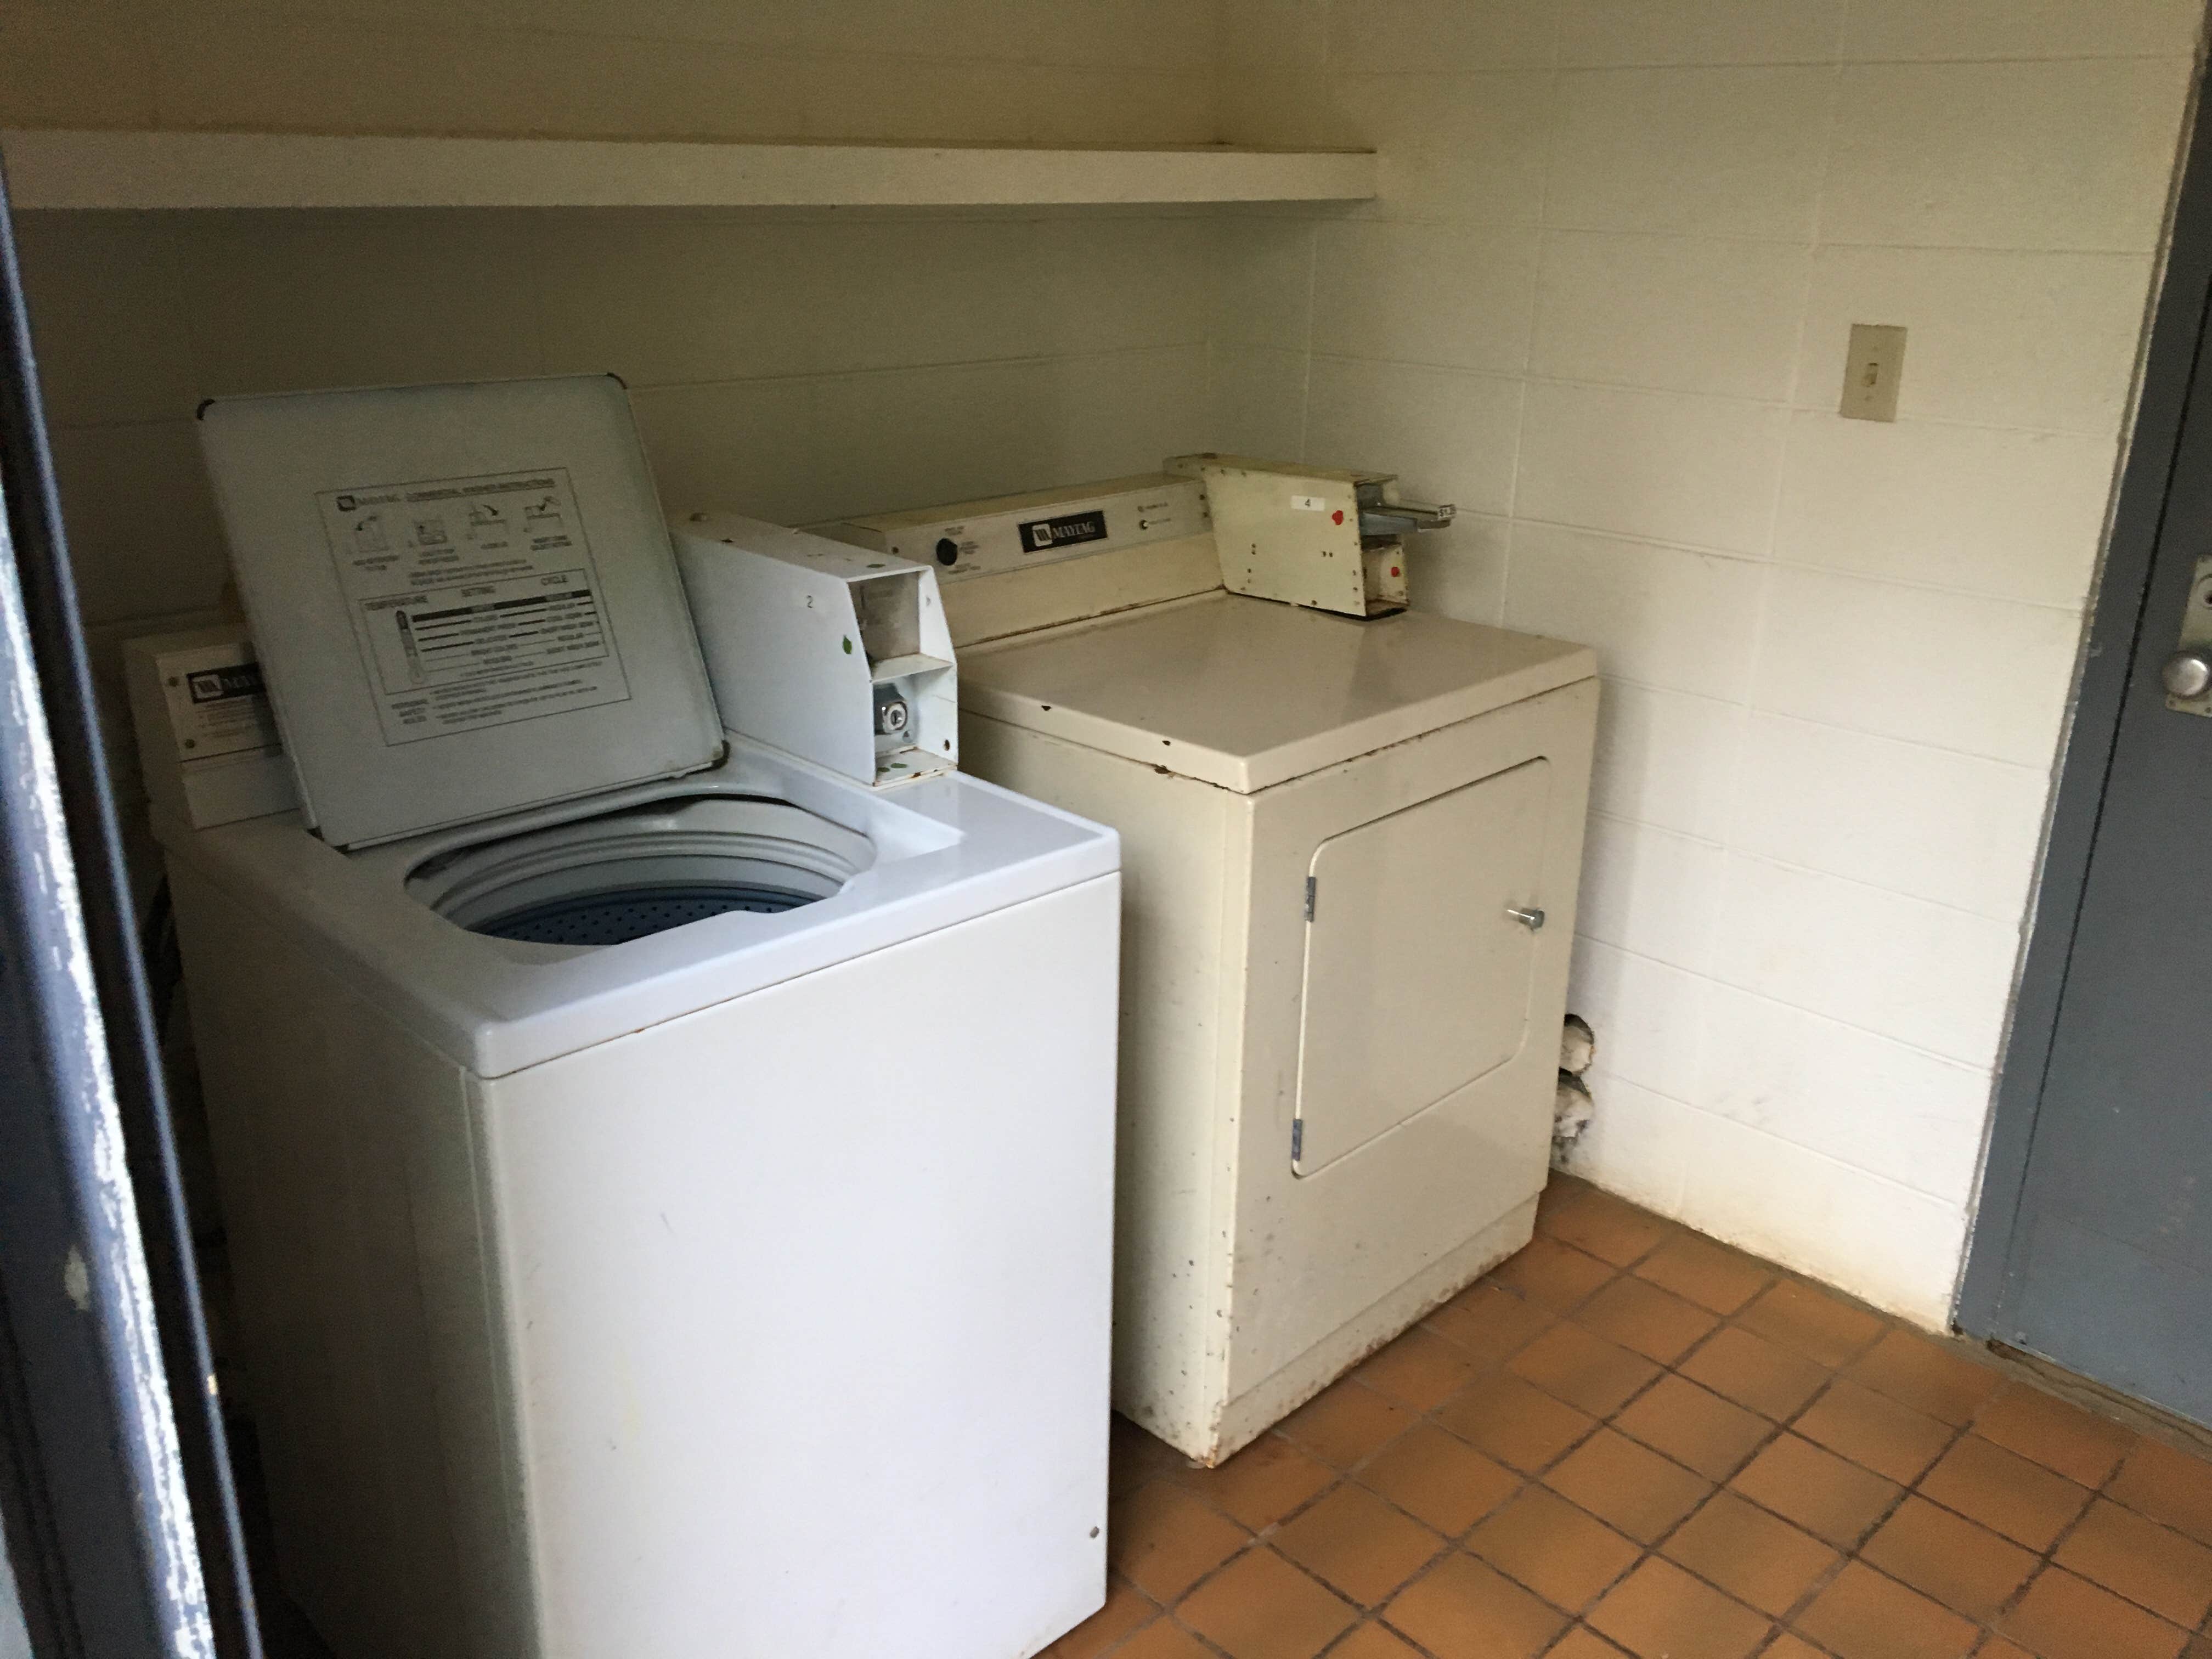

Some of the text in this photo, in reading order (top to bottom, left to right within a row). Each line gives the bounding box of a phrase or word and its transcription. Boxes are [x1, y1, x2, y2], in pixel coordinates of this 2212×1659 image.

[1305, 498, 1311, 507] 4
[1052, 521, 1096, 539] MAYTAG
[806, 595, 813, 608] 2
